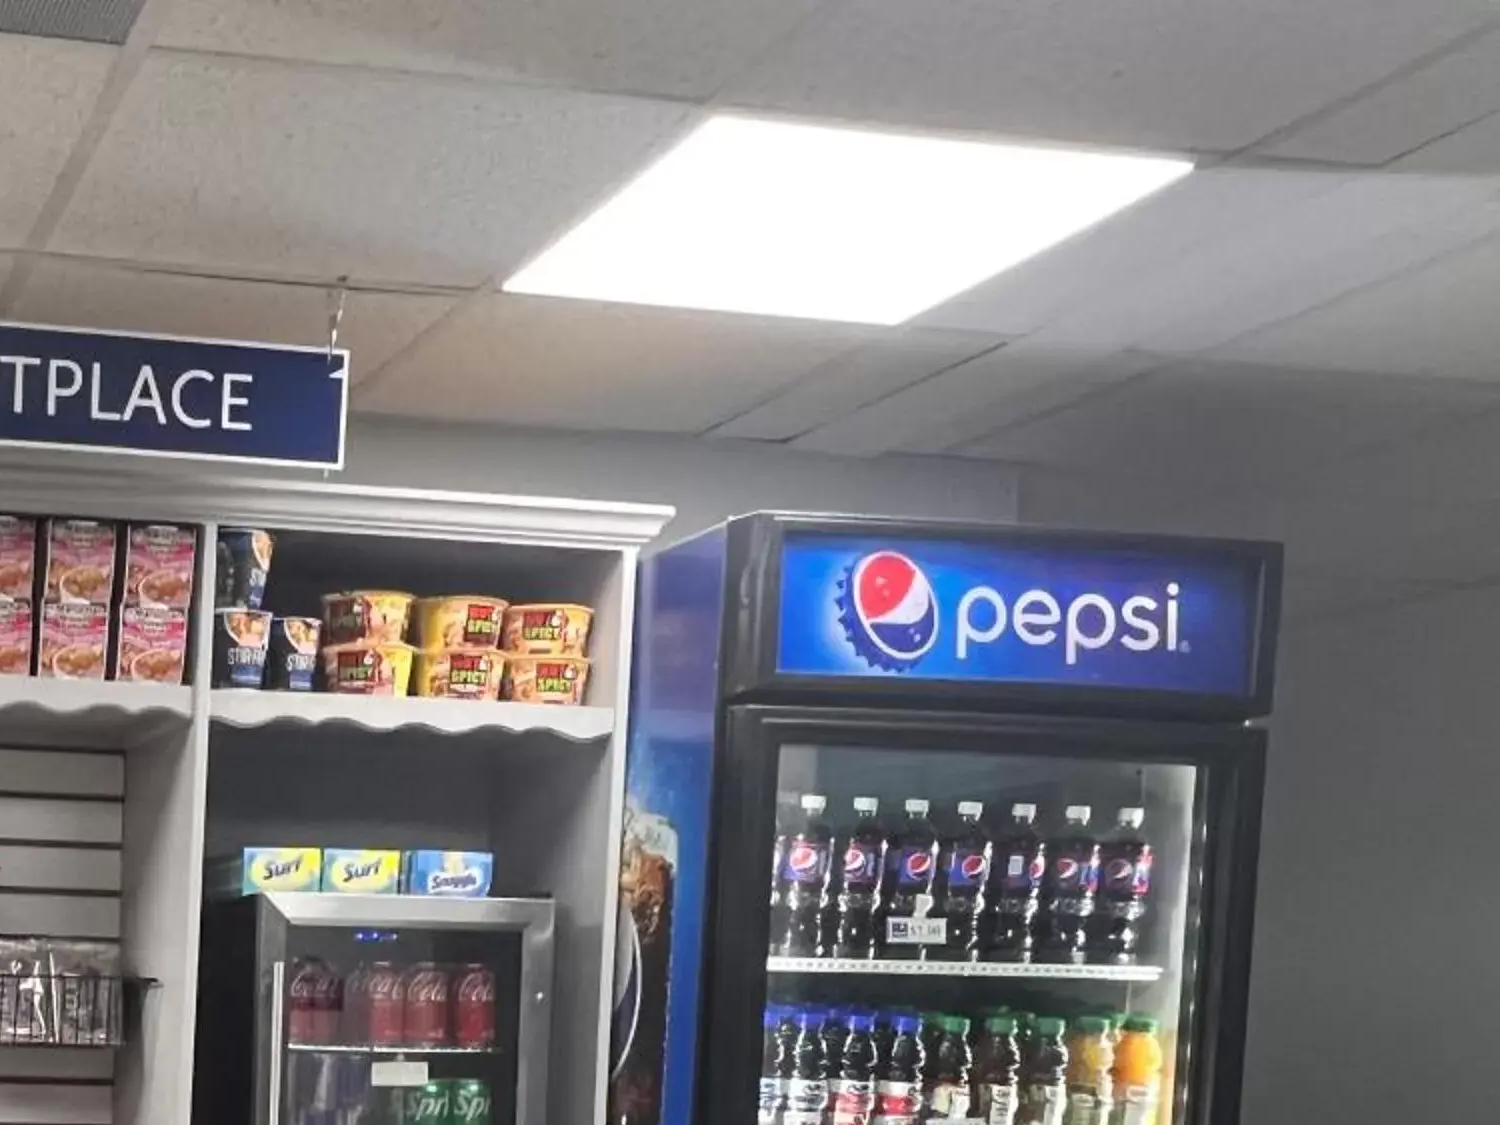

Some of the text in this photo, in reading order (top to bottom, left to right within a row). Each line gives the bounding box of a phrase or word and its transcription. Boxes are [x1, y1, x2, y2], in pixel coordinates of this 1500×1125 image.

[957, 582, 1179, 665] pepsi
[263, 856, 303, 879] Surf
[343, 859, 383, 882] Surf
